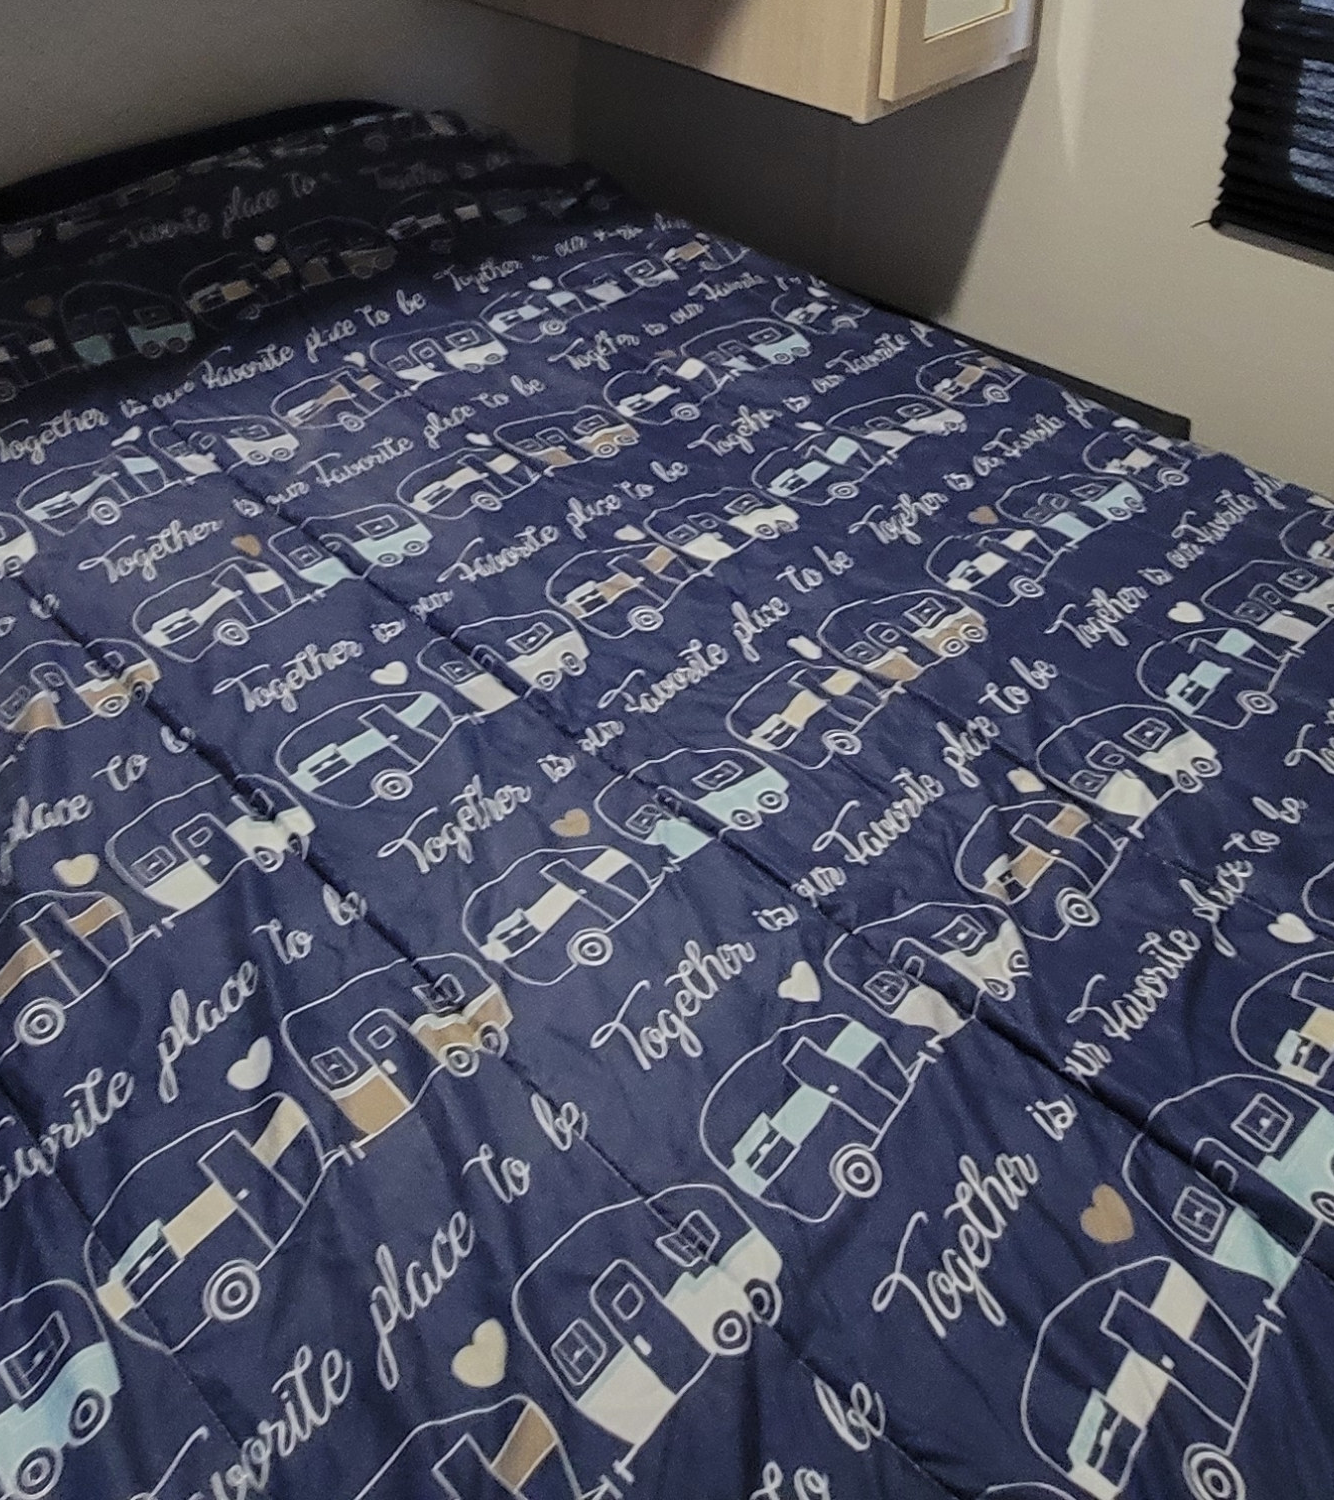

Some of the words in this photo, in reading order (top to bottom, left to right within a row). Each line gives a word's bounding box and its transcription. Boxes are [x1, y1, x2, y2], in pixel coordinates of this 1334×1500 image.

[186, 344, 295, 389] Favorite
[305, 319, 357, 361] place
[353, 305, 393, 329] to
[395, 290, 428, 321] be
[78, 516, 224, 585] Together
[232, 497, 264, 518] is
[297, 436, 416, 488] Favorite
[422, 403, 477, 449] place
[477, 388, 509, 411] to
[511, 375, 548, 397] be
[211, 639, 364, 713] Together
[370, 619, 407, 643] is
[436, 525, 560, 583] Favorite
[619, 478, 656, 499] to
[650, 459, 690, 483] be
[91, 753, 152, 792] to
[376, 776, 533, 875] Together
[537, 752, 576, 783] is
[597, 639, 730, 714] Favorite
[730, 596, 792, 662] place
[776, 565, 825, 593] to
[814, 545, 855, 577] be
[590, 940, 758, 1070] Together
[752, 903, 799, 933] is
[812, 768, 946, 865] Favorite
[978, 684, 1032, 717] to
[1009, 656, 1060, 691] be
[1222, 828, 1281, 853] to
[1251, 795, 1309, 824] be
[157, 960, 259, 1103] place
[251, 918, 314, 965] to
[1066, 927, 1202, 1041] Favorite
[1026, 1095, 1077, 1142] is
[368, 1210, 476, 1391] place
[461, 1142, 532, 1203] to
[530, 1092, 589, 1152] be
[872, 1153, 1039, 1338] Together
[812, 1376, 887, 1453] be
